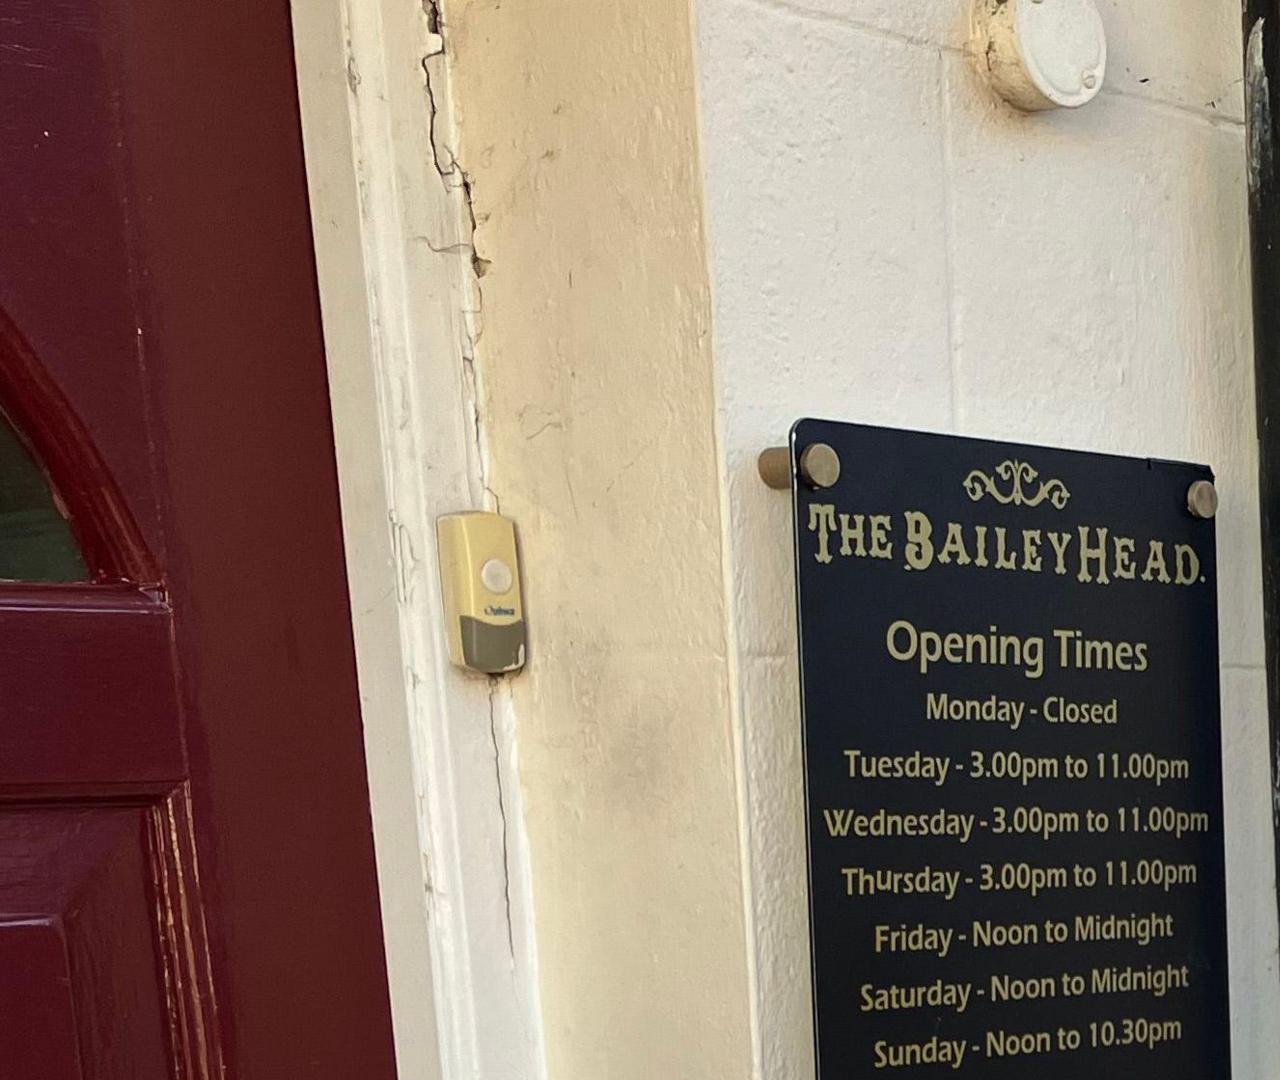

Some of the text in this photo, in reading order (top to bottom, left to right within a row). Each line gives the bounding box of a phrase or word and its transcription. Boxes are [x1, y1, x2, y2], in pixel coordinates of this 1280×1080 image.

[808, 504, 892, 563] THE
[887, 621, 1147, 678] Opening Times
[927, 693, 1024, 729] Monday
[1044, 697, 1117, 723] Closed
[844, 750, 949, 785] Tuesday
[970, 751, 1058, 785] 3.00pm
[1065, 755, 1087, 778] to
[1098, 753, 1188, 785] 11.00pm
[824, 809, 974, 842] Wednesday
[993, 807, 1078, 839] 3.00pm
[1087, 810, 1108, 832] to
[1119, 807, 1207, 838] 11.00pm
[842, 866, 959, 899] Thursday
[980, 863, 1066, 896] 3.00pm
[1074, 865, 1096, 886] to
[1107, 860, 1196, 891] 11.00pm
[876, 924, 952, 957] Friday
[974, 921, 1037, 946] Noon
[1045, 921, 1067, 942] to
[1075, 913, 1172, 945] Midnight
[861, 980, 971, 1012] Saturday
[992, 976, 1054, 1001] Noon
[1062, 974, 1084, 995] to
[1092, 965, 1188, 996] Midnight
[875, 1037, 966, 1068] Sunday
[987, 1031, 1050, 1056] Noon
[1058, 1028, 1080, 1049] to
[1090, 1019, 1181, 1048] 10.30pm
